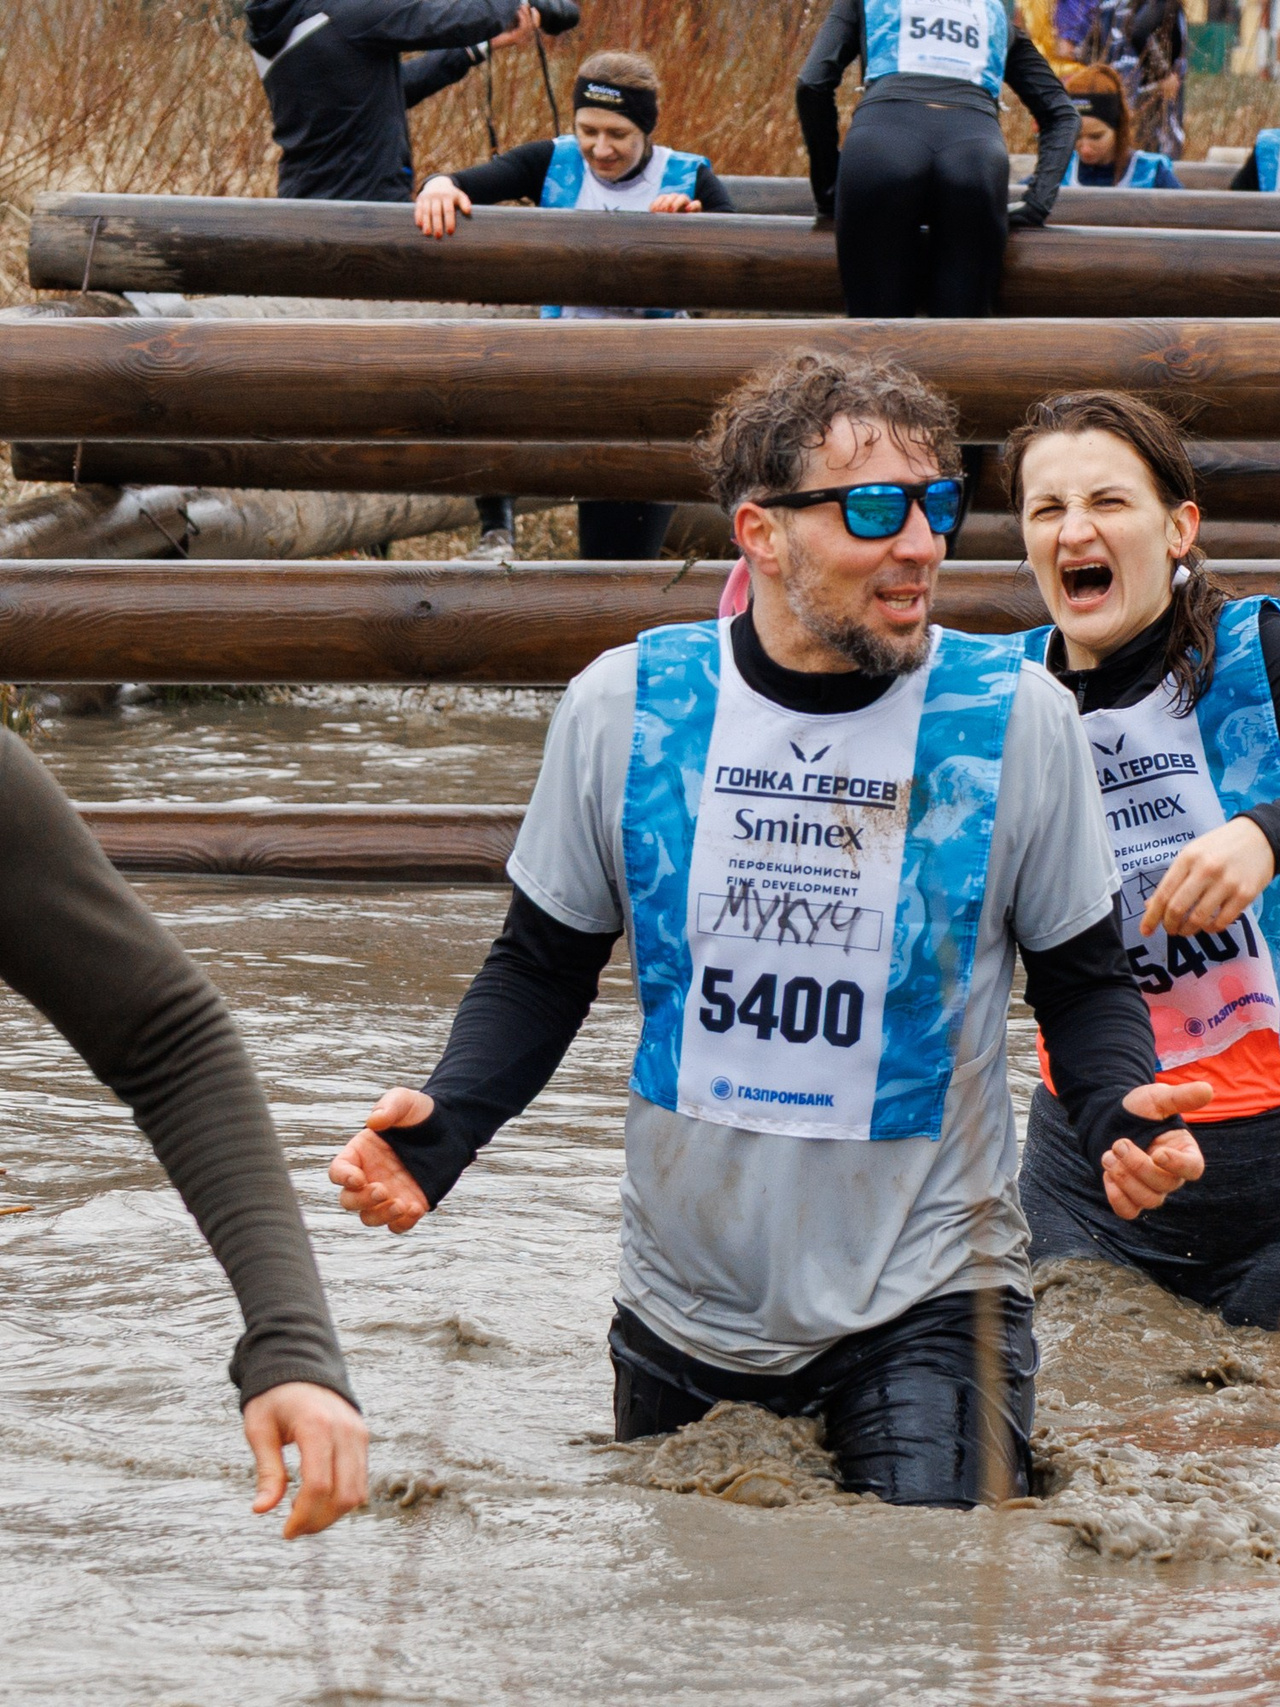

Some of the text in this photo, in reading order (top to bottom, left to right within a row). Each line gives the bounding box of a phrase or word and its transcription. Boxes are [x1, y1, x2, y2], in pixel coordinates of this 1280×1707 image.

[909, 16, 979, 49] 5456
[1118, 753, 1196, 780] ГЕРОЕВ
[716, 766, 898, 802] ГОНКА ГЕРОЕВ
[1106, 793, 1186, 831] minex
[733, 808, 864, 850] Sminex
[728, 858, 861, 880] ПЕРФЕКЦИОНИСТЫ
[1122, 850, 1179, 872] DEVELOPM
[726, 876, 858, 897] FINE DEVELOPMENT
[699, 965, 865, 1048] 5400
[1207, 992, 1276, 1029] ГАЗПРОМБАНК
[737, 1085, 835, 1107] ГАЗПРОМБАНК
